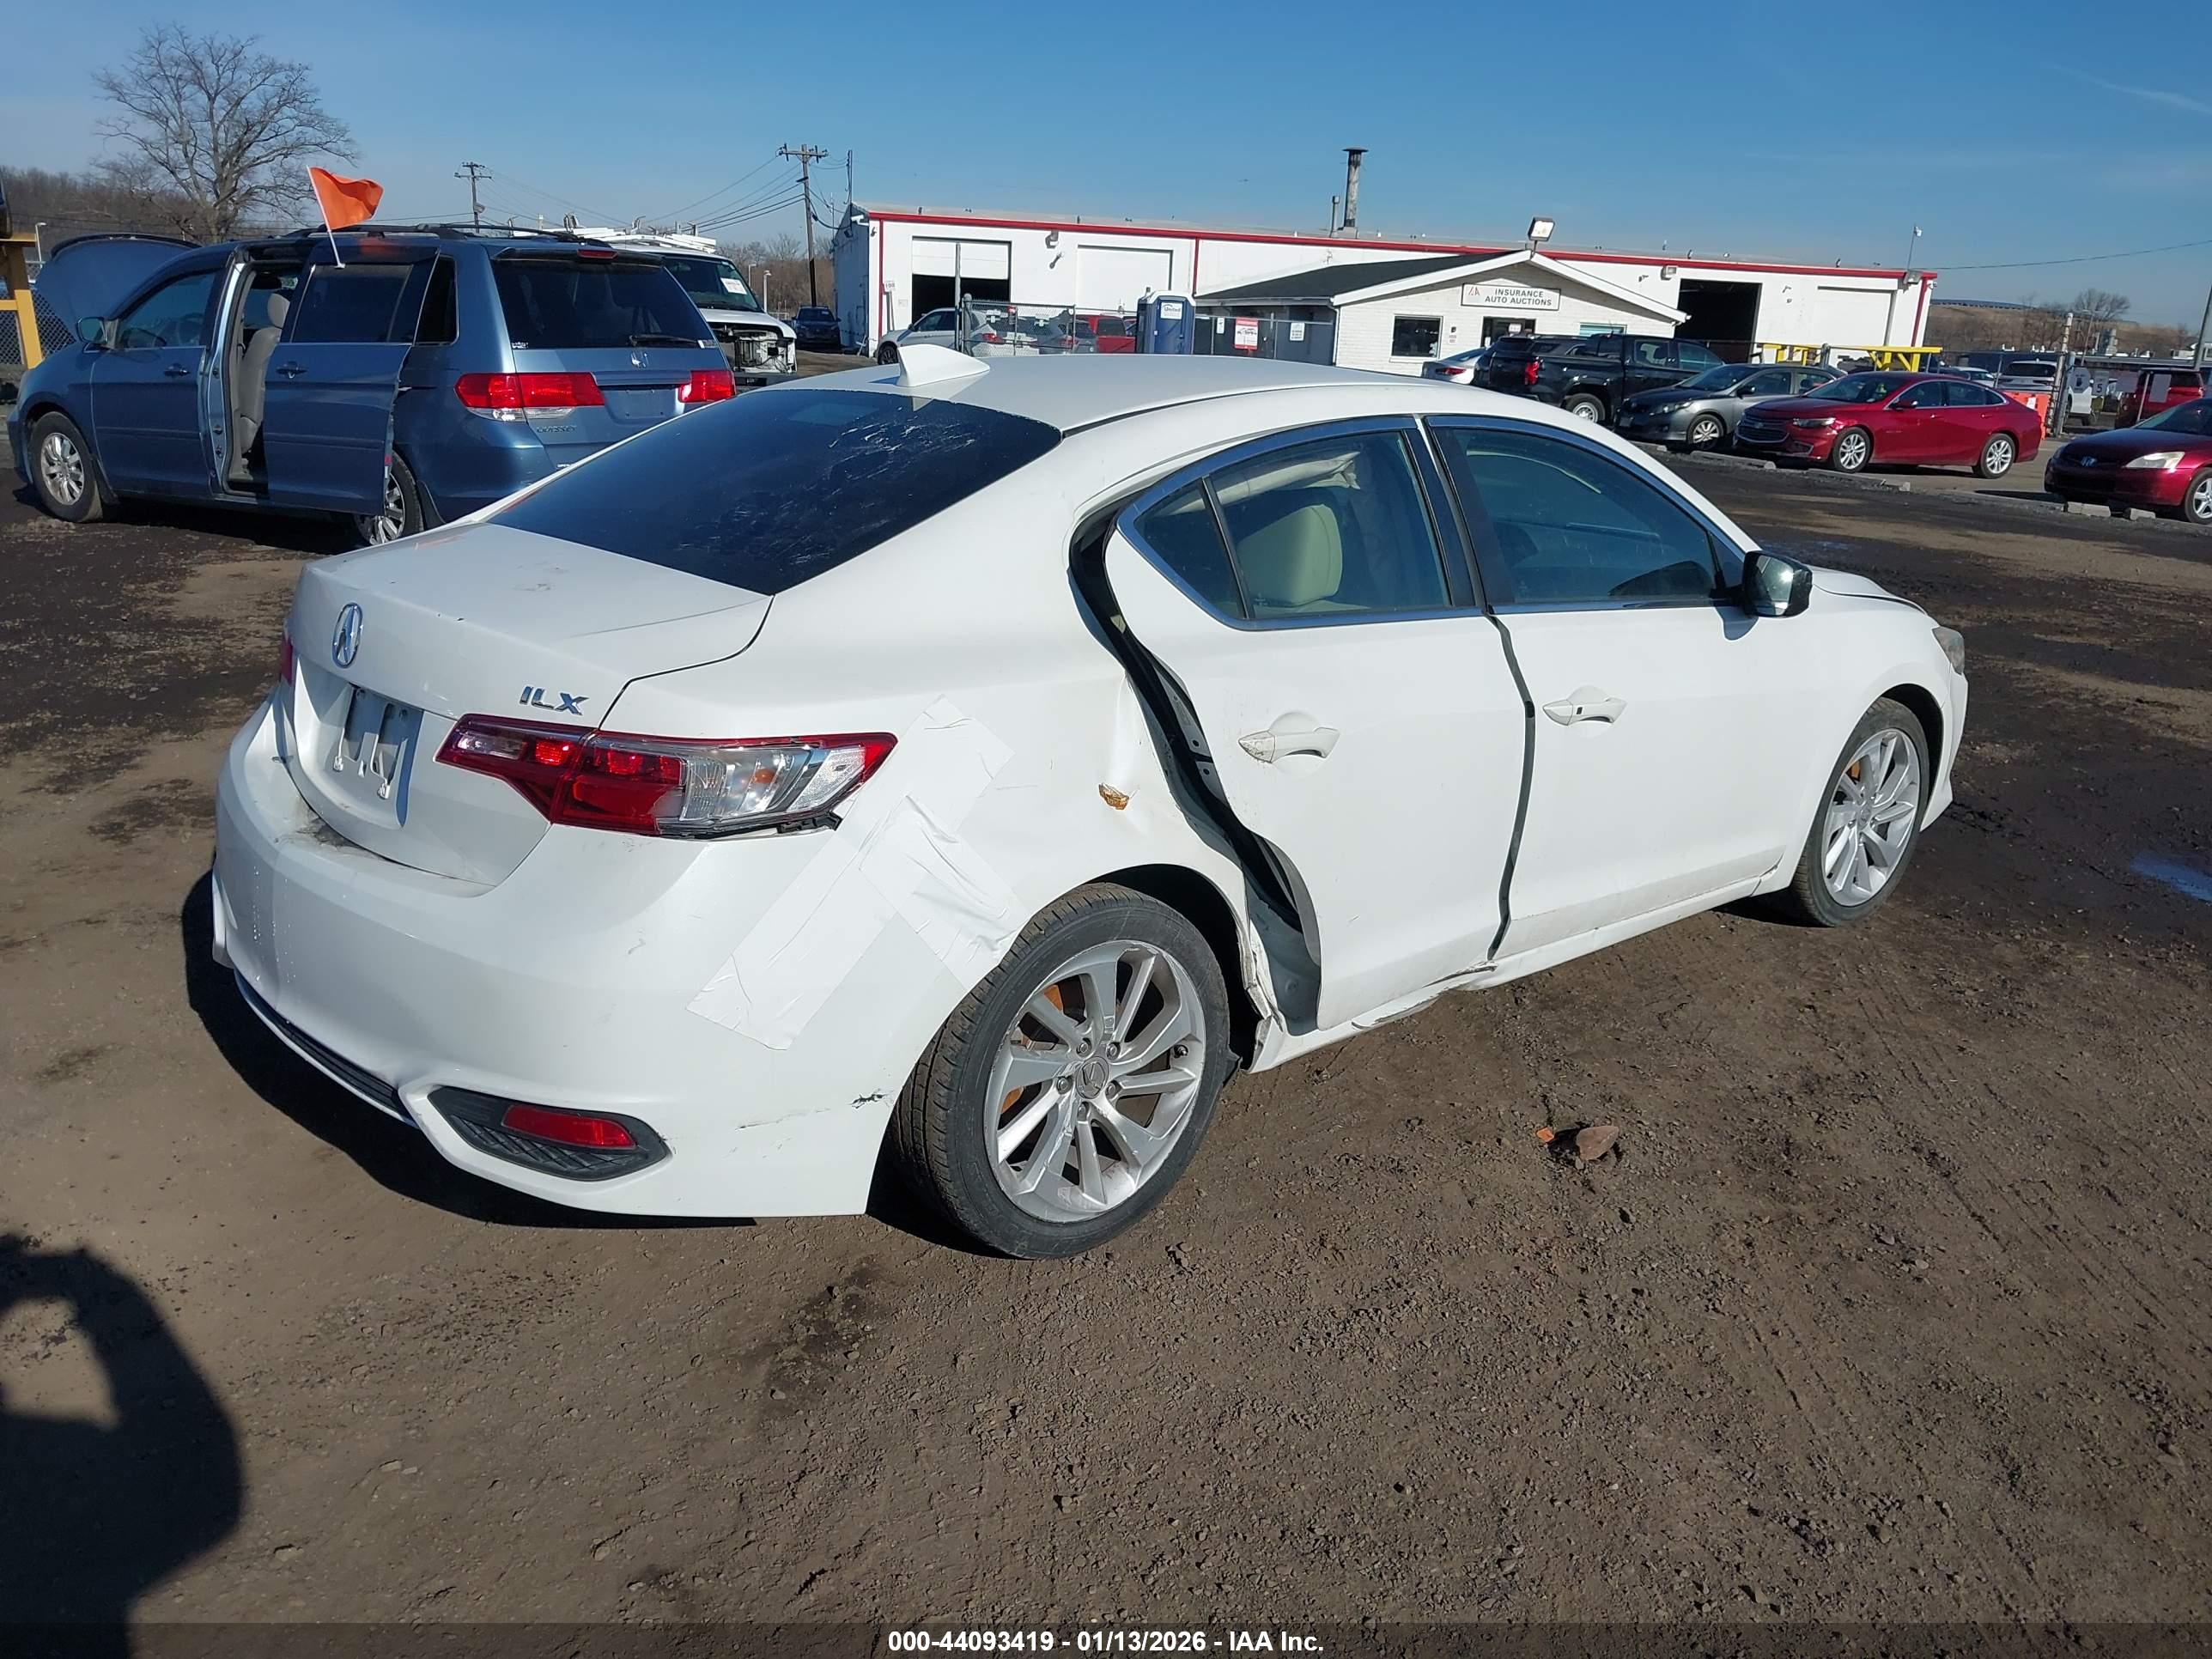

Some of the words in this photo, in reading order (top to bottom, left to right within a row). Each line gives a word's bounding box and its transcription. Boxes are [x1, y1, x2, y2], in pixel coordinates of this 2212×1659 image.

[1495, 289, 1544, 298] INSURANCE
[1485, 295, 1508, 304] AUTO
[1510, 297, 1552, 307] AUCTIONS
[2096, 383, 2103, 393] 5
[519, 685, 590, 716] ILX
